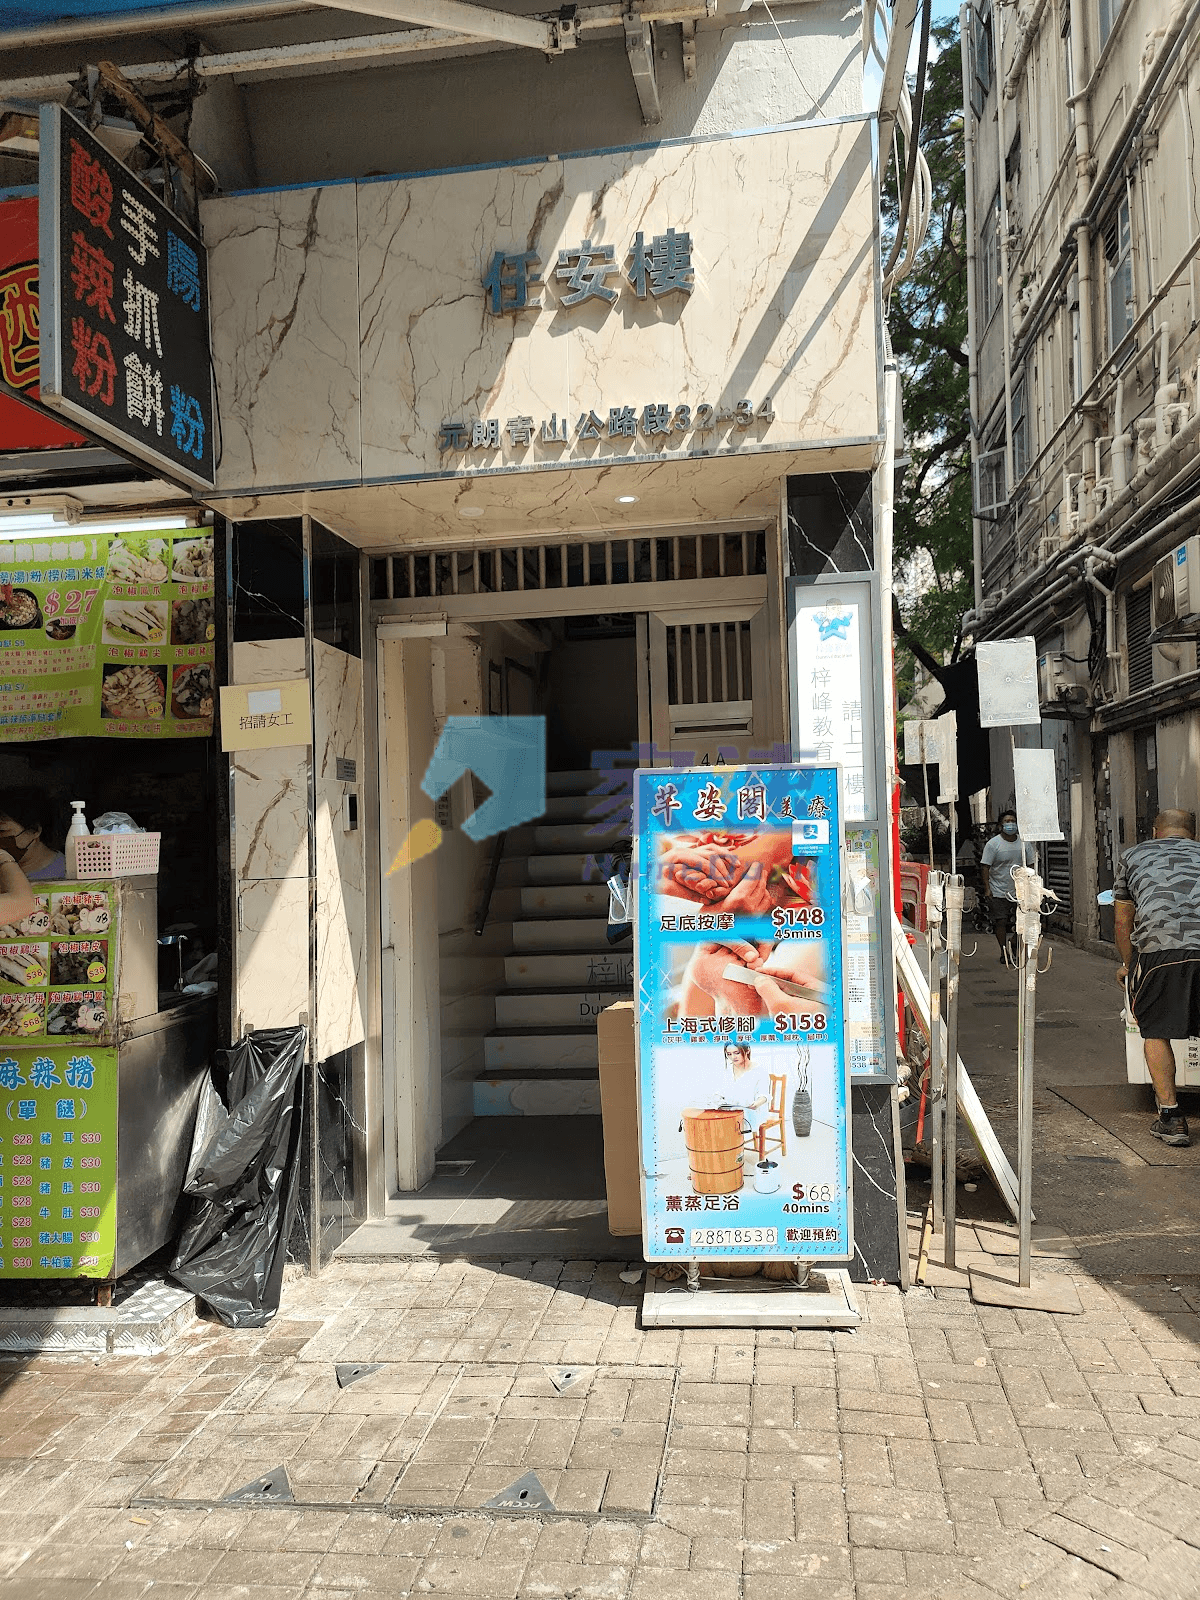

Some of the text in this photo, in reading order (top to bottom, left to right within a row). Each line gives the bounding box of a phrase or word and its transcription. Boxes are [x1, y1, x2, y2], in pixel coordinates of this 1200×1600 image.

[70, 137, 118, 407] 酸辣粉
[484, 228, 696, 316] 任安樓
[120, 188, 163, 436] 手抓餅
[438, 396, 776, 451] 元朗青山公路段32-34
[43, 589, 99, 617] $27
[811, 667, 834, 762] 梓峰教育
[239, 713, 294, 730] 招請女工
[841, 699, 866, 795] 請上二樓
[779, 795, 830, 820] 美療
[660, 914, 734, 931] 足底按摩
[772, 907, 824, 927] $148
[774, 928, 822, 939] 45mins
[59, 941, 101, 953] 泡椒豬皮
[26, 970, 43, 981] $38
[89, 966, 105, 978] $38
[23, 1017, 40, 1029] $68
[662, 1016, 755, 1034] 上海式修腳
[775, 1013, 827, 1033] $158
[0, 1056, 96, 1090] 麻辣撈
[12, 1134, 33, 1145] $28
[81, 1132, 101, 1144] $30
[12, 1155, 33, 1165] $28
[80, 1157, 101, 1168] $30
[12, 1175, 33, 1186] $28
[80, 1182, 101, 1193] $30
[792, 1182, 831, 1201] $68
[12, 1196, 33, 1207] $28
[665, 1195, 740, 1211] 薰蒸足浴
[80, 1207, 100, 1218] $30
[782, 1203, 830, 1213] 40mins
[12, 1217, 33, 1228] $28
[12, 1237, 33, 1248] $28
[39, 1231, 100, 1244] 豬大腸 $30
[695, 1228, 837, 1245] 28878538 歡迎預約
[12, 1257, 33, 1268] $30
[497, 1500, 542, 1509] PCCW
